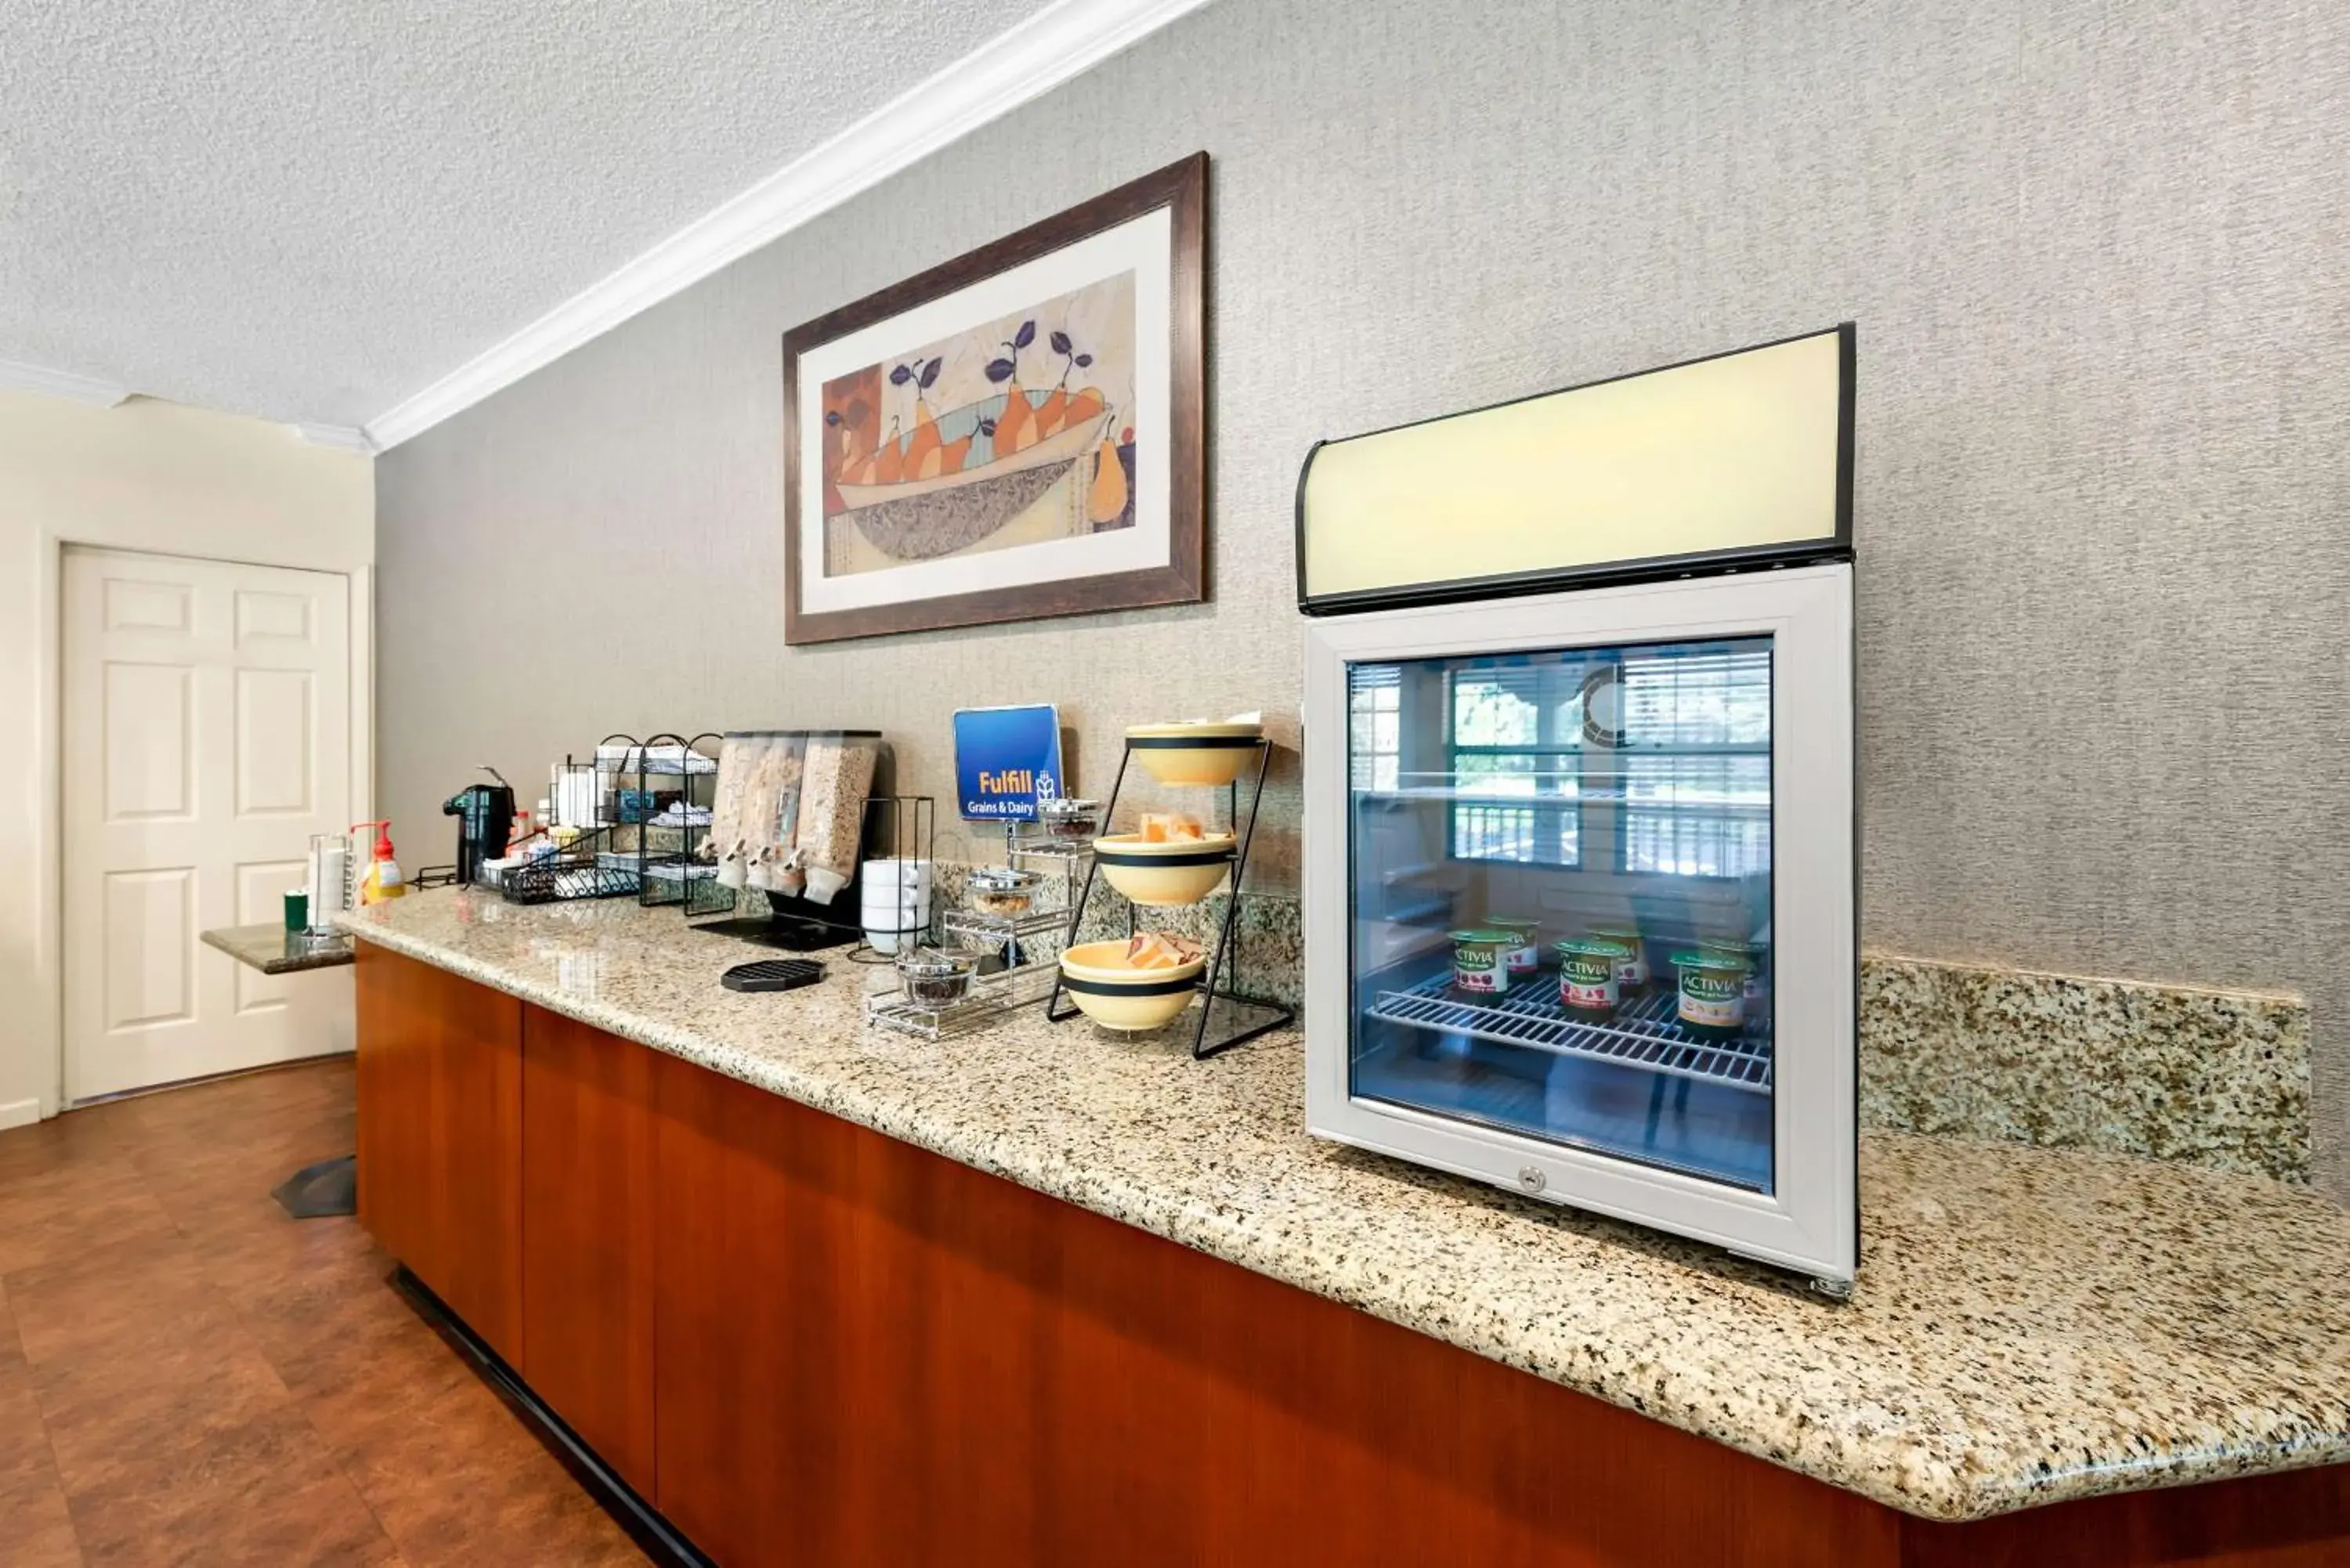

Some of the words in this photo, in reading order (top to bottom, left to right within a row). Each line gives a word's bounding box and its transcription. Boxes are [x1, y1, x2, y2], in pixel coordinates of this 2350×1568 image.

[979, 769, 1032, 794] Fulfill
[967, 800, 998, 814] Grains
[999, 800, 1007, 814] &
[1007, 800, 1033, 817] Dairy
[1455, 948, 1494, 963] CTIVIA
[1683, 977, 1737, 992] ACTIVIA
